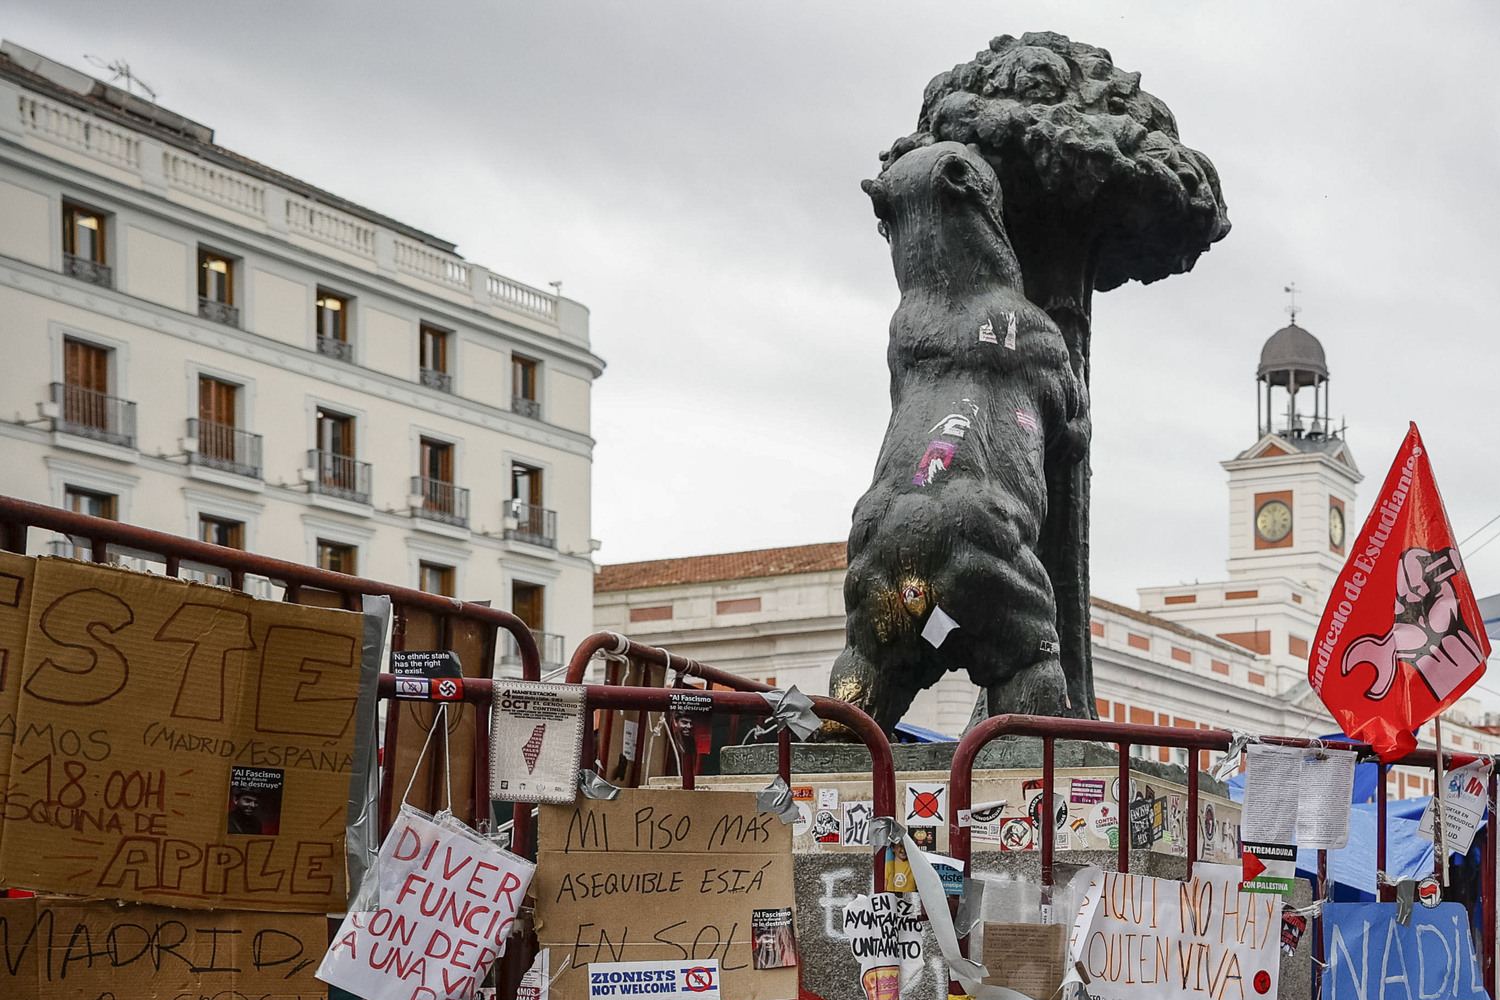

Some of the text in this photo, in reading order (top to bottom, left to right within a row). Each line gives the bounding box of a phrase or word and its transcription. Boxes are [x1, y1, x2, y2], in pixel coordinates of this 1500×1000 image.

[1314, 445, 1422, 699] Sindicato de Estudiantes
[0, 572, 358, 738] STE
[407, 653, 430, 661] ethnic
[424, 660, 441, 669] right
[502, 689, 557, 698] 4 MANIFESTACIÓN
[565, 807, 773, 853] MI PISO MÁS
[97, 836, 334, 895] APPLE
[1243, 845, 1293, 856] EXTREMADURA
[393, 826, 521, 913] DIVER
[556, 860, 772, 903] ASEQUIBLE ESTÁ
[1243, 880, 1289, 891] CON PALESTINA
[872, 895, 890, 912] EN
[571, 921, 748, 971] EN SOL
[1087, 931, 1169, 984] QUIEN
[591, 970, 676, 984] ZIONISTS
[592, 983, 677, 996] NOT WELCOME
